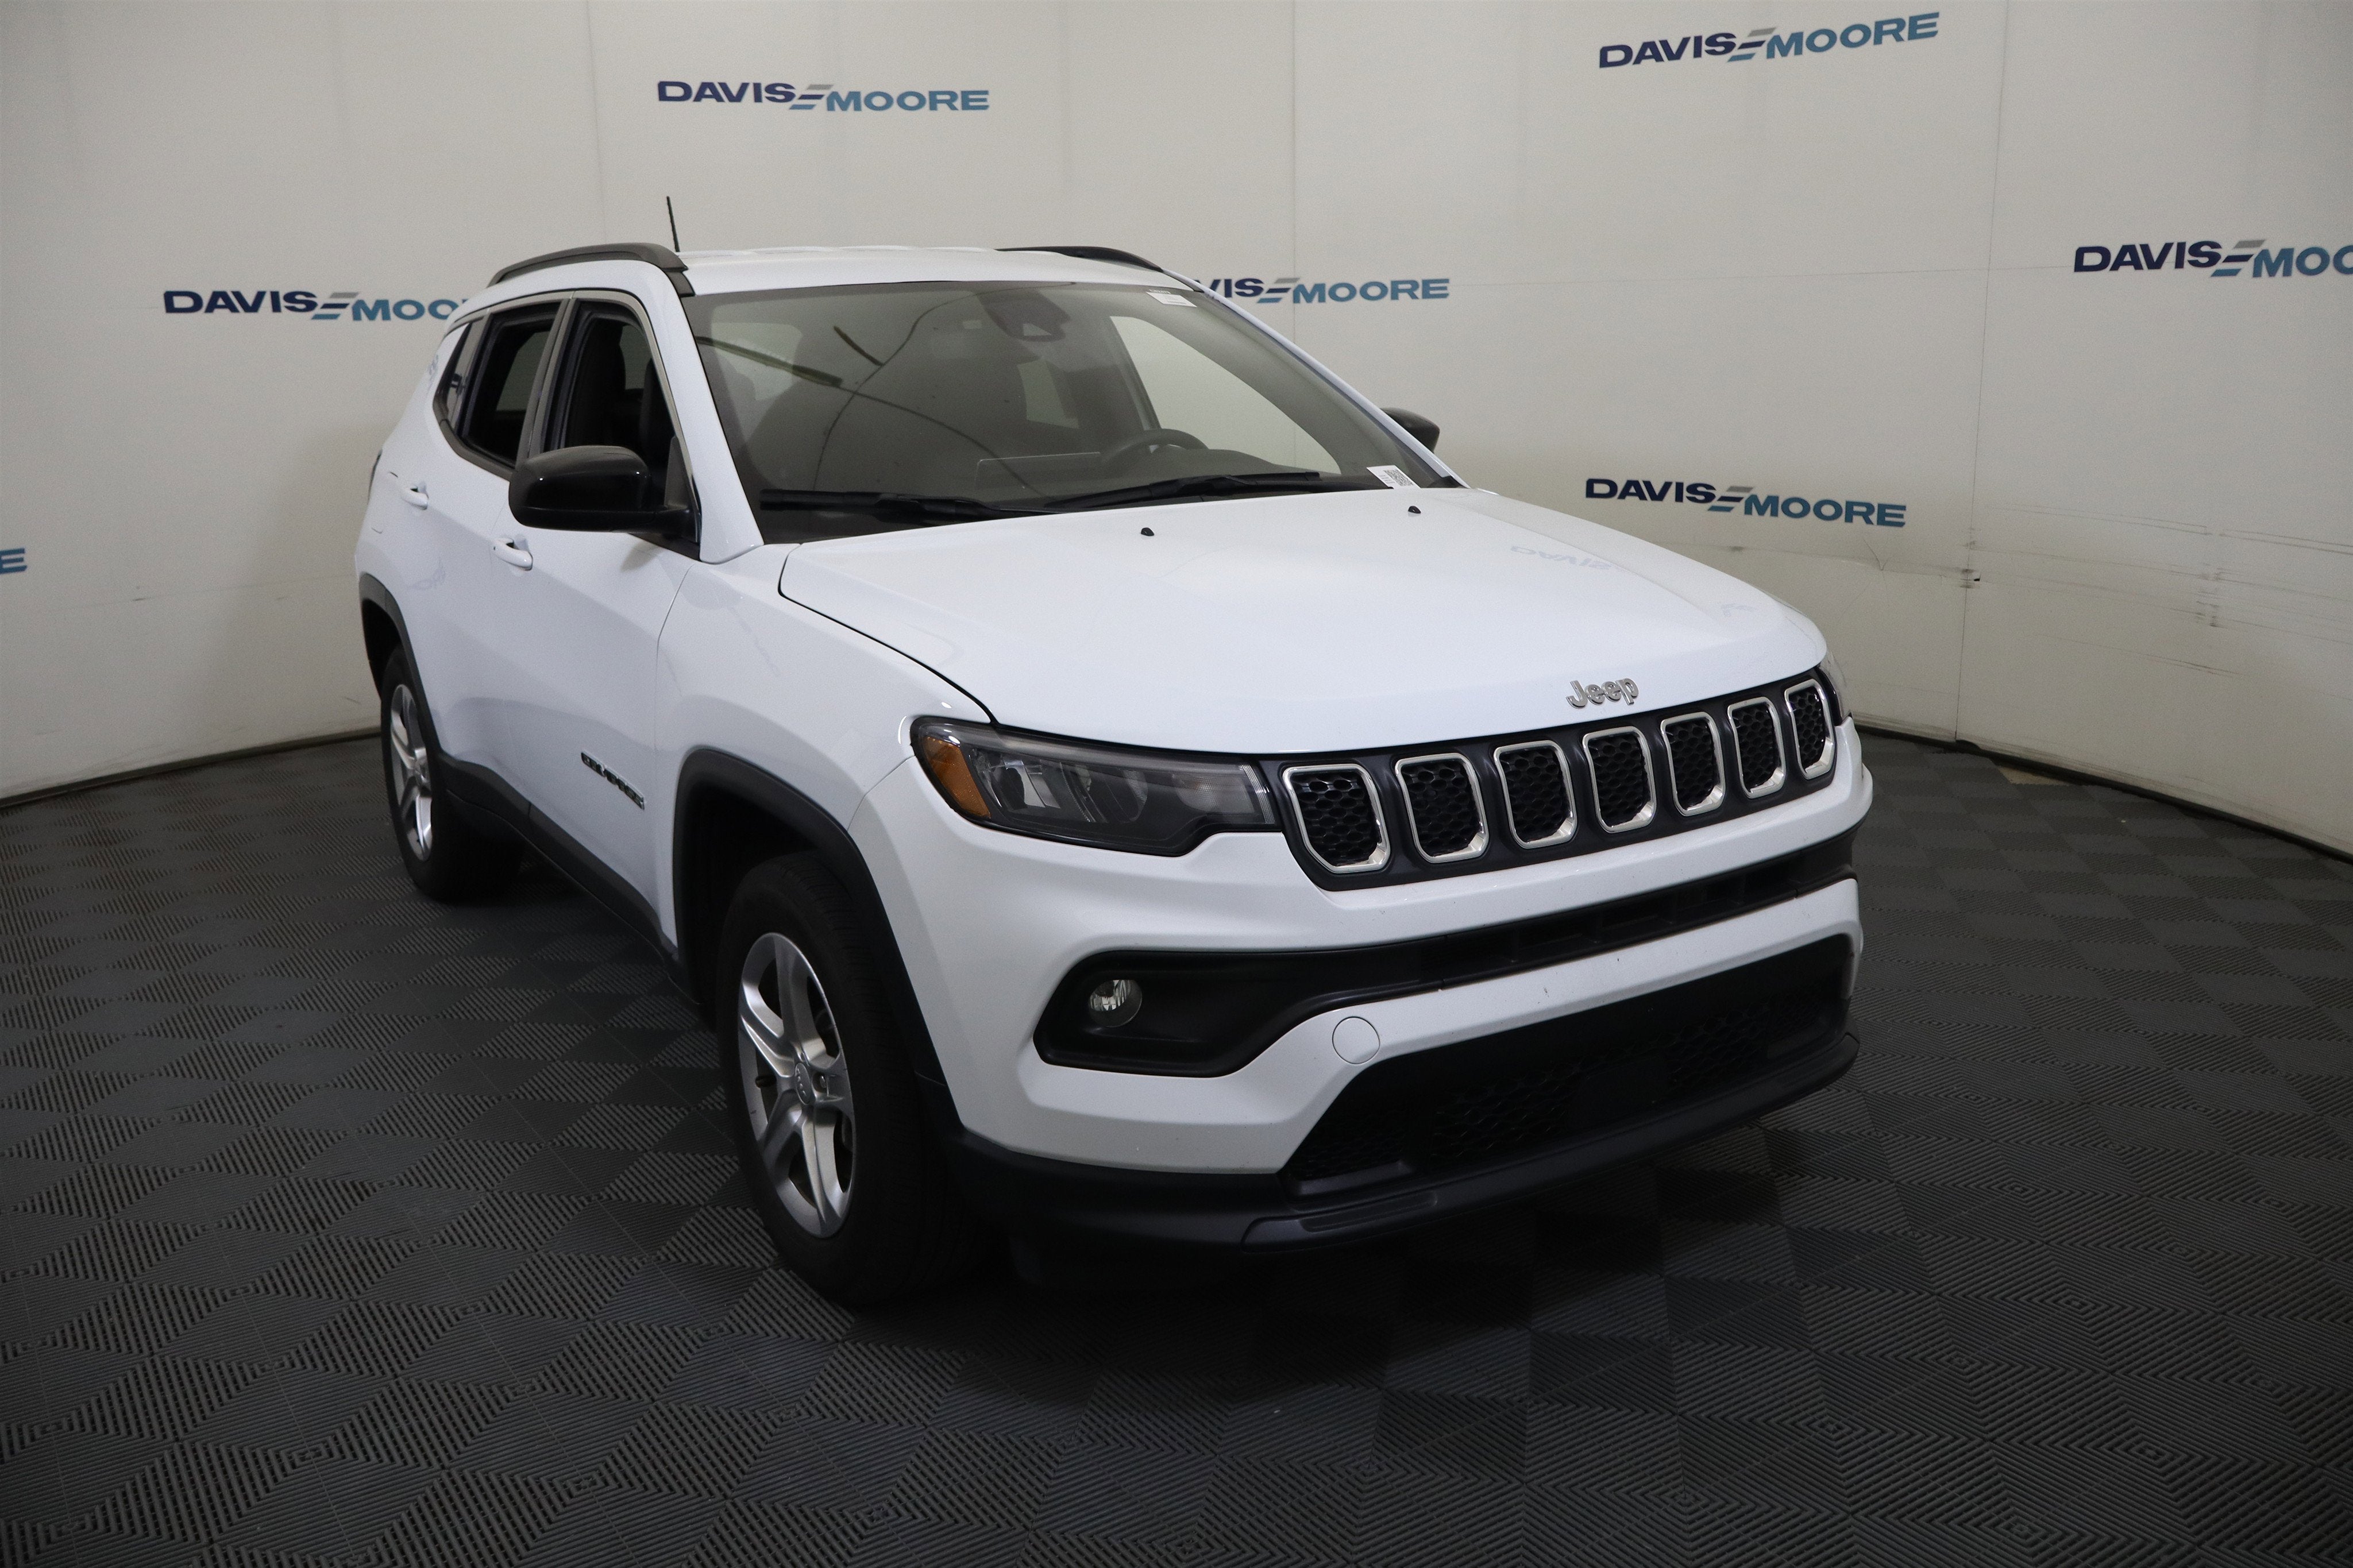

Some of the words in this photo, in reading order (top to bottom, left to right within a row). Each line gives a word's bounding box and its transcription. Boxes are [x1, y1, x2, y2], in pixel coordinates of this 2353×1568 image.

[1599, 32, 1737, 68] DAVIS
[1766, 11, 1939, 59] MOORE
[657, 81, 796, 103] DAVIS
[826, 90, 989, 111] MOORE
[2074, 241, 2222, 272] DAVIS
[163, 290, 318, 314] DAVIS
[352, 299, 468, 321] MOO
[1293, 279, 1449, 304] MOORE
[1586, 478, 1716, 504] DAVIS
[1744, 494, 1906, 528] MOORE
[1565, 678, 1639, 709] Jeep
